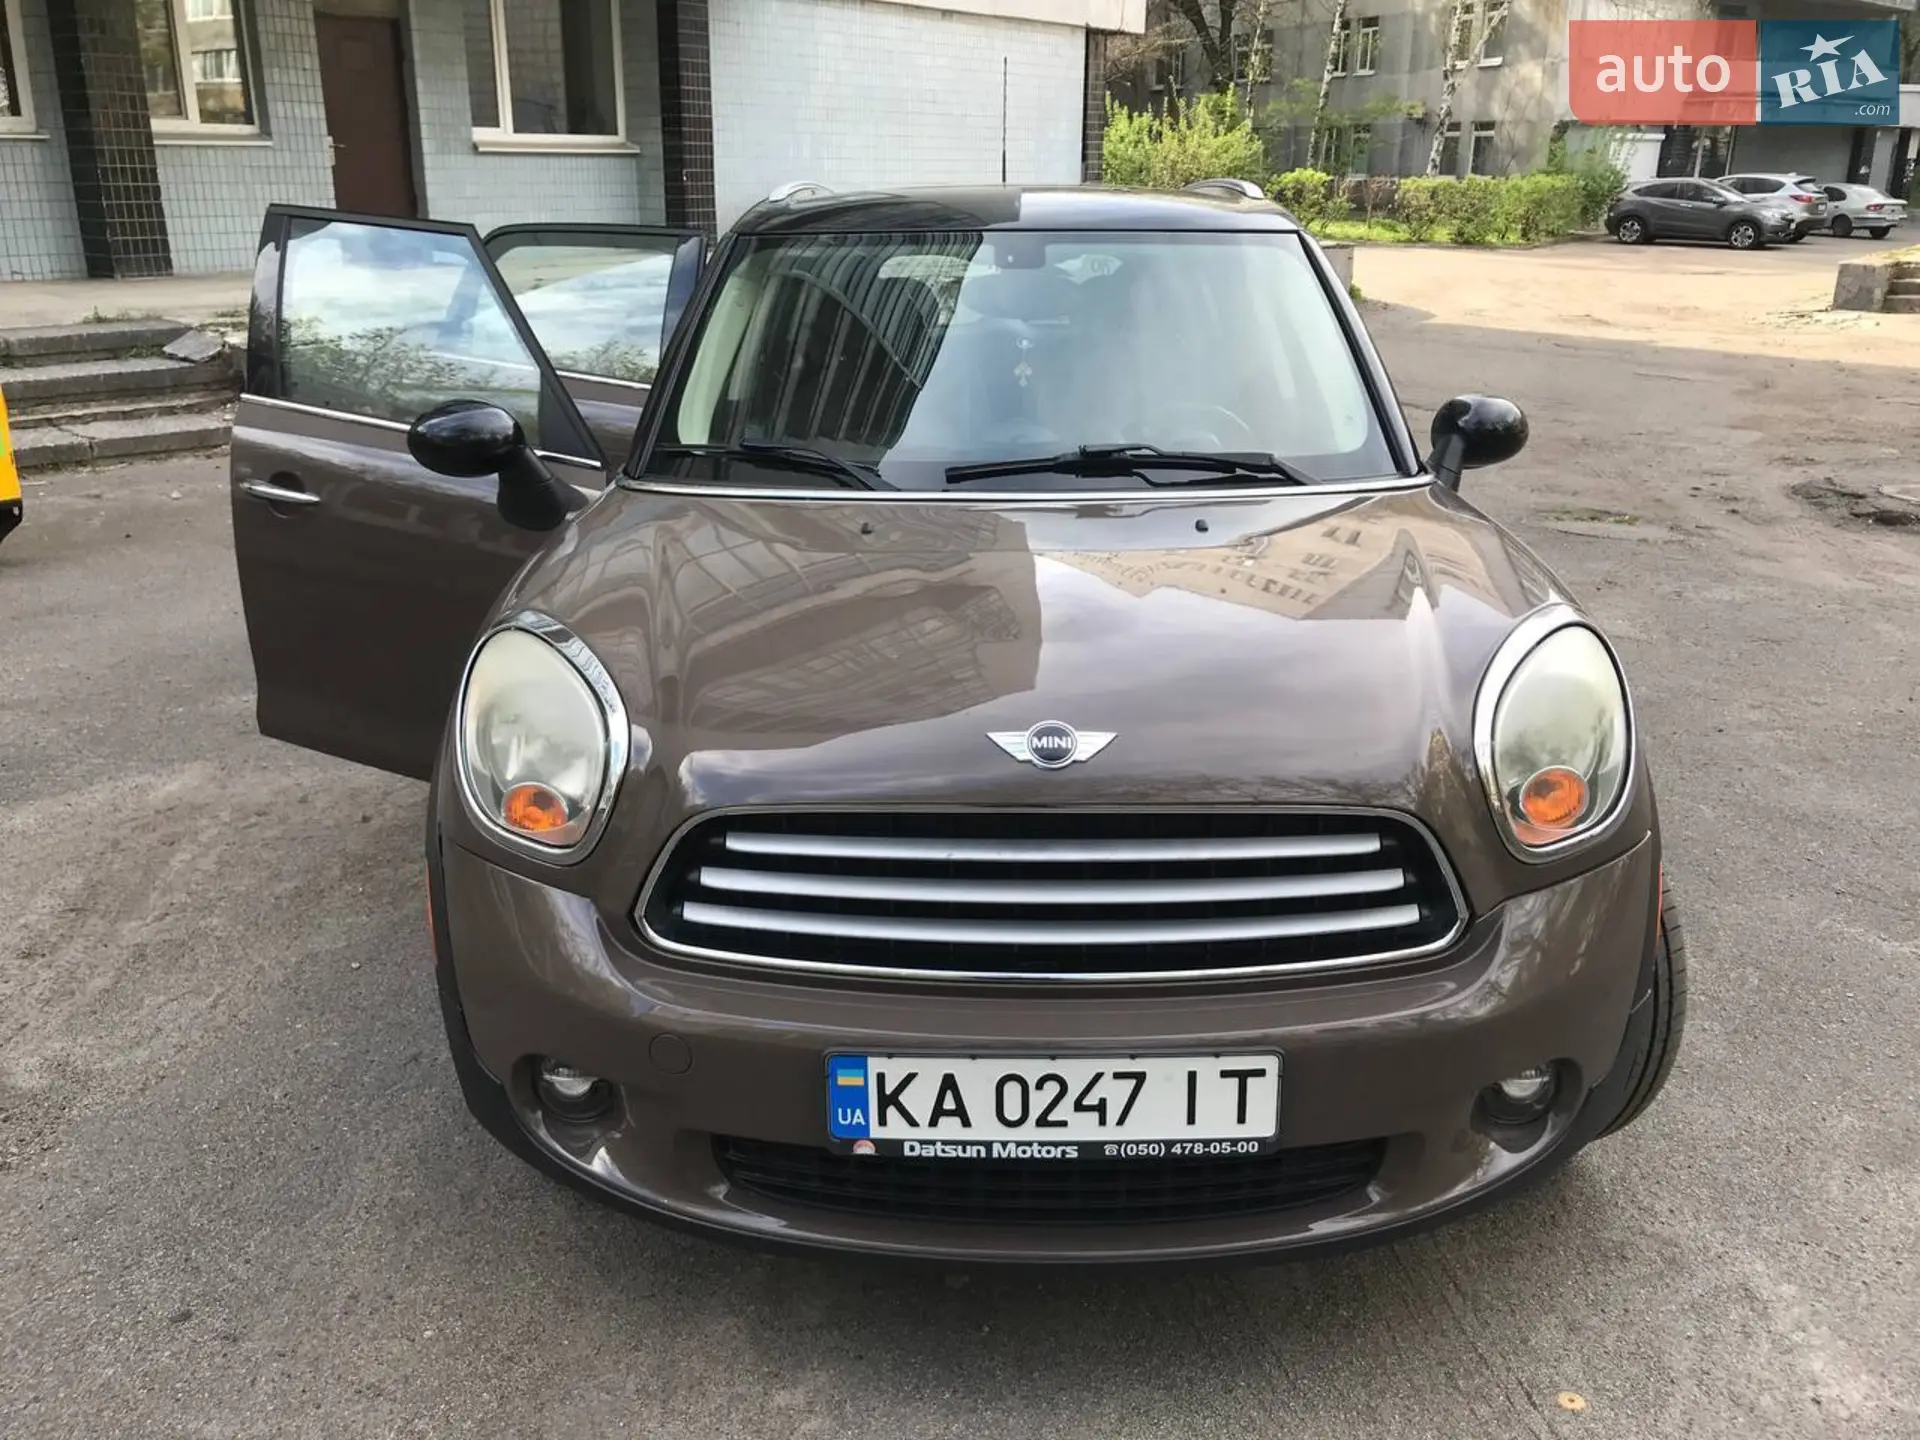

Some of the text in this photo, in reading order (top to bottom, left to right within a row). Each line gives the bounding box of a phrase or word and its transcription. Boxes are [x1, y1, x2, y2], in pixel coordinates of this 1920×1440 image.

[1032, 735, 1072, 749] MINI
[876, 1072, 972, 1127] KA
[994, 1072, 1147, 1128] 0247
[838, 1109, 866, 1125] UA
[903, 1140, 1079, 1158] Datsun Motors
[1171, 1141, 1259, 1155] 478-05-00
